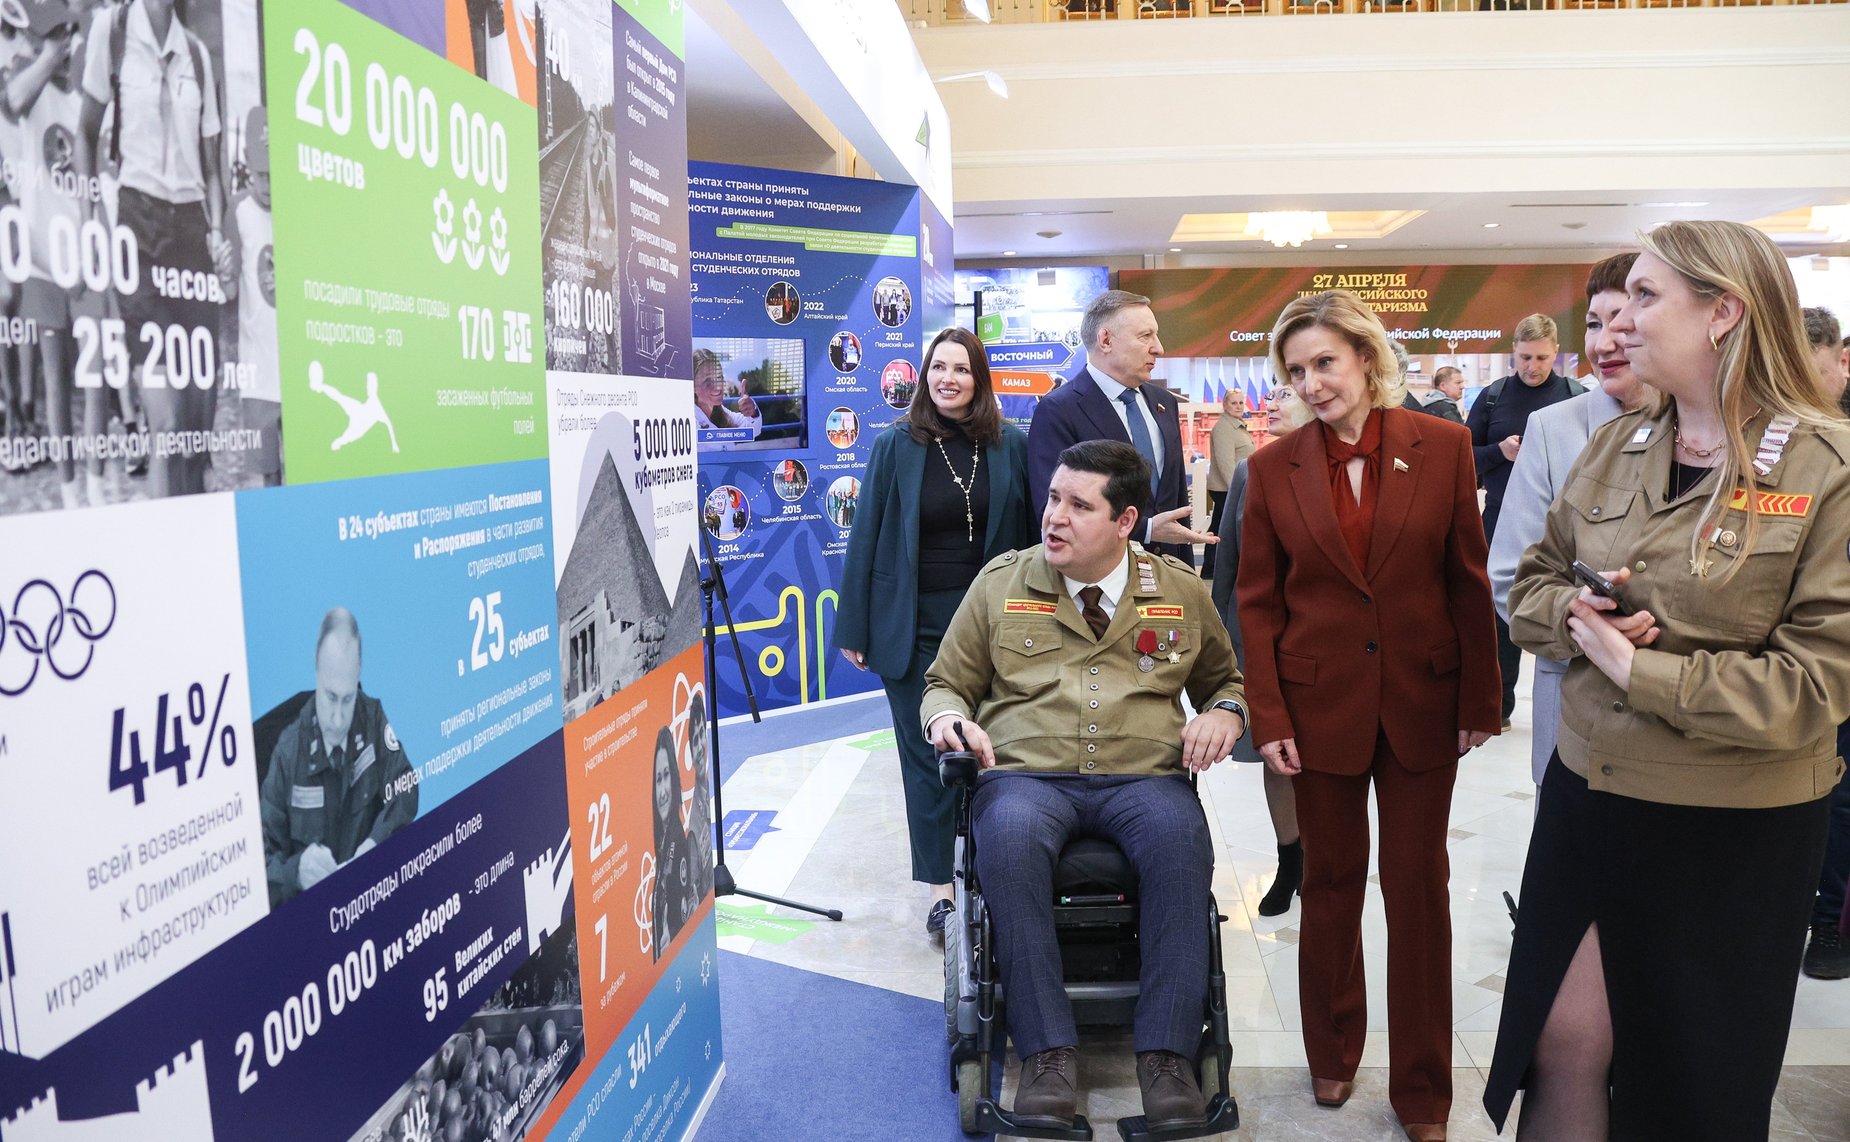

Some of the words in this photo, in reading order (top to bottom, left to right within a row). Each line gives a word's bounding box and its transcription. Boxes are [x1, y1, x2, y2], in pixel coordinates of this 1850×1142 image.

[294, 28, 352, 136] 20
[366, 62, 439, 168] 000
[450, 102, 507, 193] 000
[51, 161, 113, 205] боле
[298, 143, 365, 190] цветов
[725, 180, 763, 192] страны
[765, 184, 809, 197] приняты
[721, 207, 775, 219] движения
[725, 193, 763, 205] законы
[774, 198, 804, 209] мерах
[807, 201, 861, 215] поддержки
[48, 213, 140, 295] 000
[692, 264, 759, 276] СТУДЕНЧЕСКИХ
[761, 267, 800, 278] ОТРЯДОВ
[744, 253, 795, 265] ОТДЕЛЕНИЯ
[304, 279, 362, 307] посадили
[365, 288, 414, 314] трудовые
[1312, 274, 1334, 288] 27
[1336, 273, 1407, 288] АПРЕЛЯ
[1354, 288, 1428, 300] СИЙСКОГО
[552, 279, 581, 330] 160
[585, 286, 613, 335] 000
[804, 302, 824, 311] 2022
[72, 316, 129, 389] 25
[139, 321, 215, 390] 200
[222, 361, 257, 390] лет
[306, 320, 375, 346] подростков
[386, 328, 403, 347] это
[458, 305, 495, 361] 170
[885, 332, 903, 341] 2021
[991, 348, 1054, 362] ВОСТОЧНЫЙ
[1229, 330, 1265, 342] Совет
[1432, 328, 1502, 343] Федерации
[836, 376, 857, 386] 2020
[1002, 377, 1031, 387] КАМАЗ
[155, 430, 262, 458] деятельности
[633, 419, 642, 462] 5
[645, 418, 668, 460] 000
[671, 417, 692, 457] 000
[836, 453, 855, 462] 2018
[635, 465, 676, 494] кубометров
[676, 464, 693, 481] снега
[338, 517, 347, 541] В
[350, 515, 363, 539] 24
[365, 510, 418, 540] субъектах
[420, 505, 453, 528] страны
[454, 499, 487, 519] имеются
[488, 490, 542, 513] Постановления
[782, 505, 802, 514] 2015
[414, 543, 421, 560] и
[422, 529, 485, 558] Распоряжения
[493, 524, 513, 541] части
[514, 516, 543, 536] развития
[718, 544, 739, 554] 2014
[468, 550, 517, 580] студенческих
[458, 659, 464, 677] в
[469, 591, 504, 672] 25
[509, 624, 549, 657] субъектах
[441, 706, 475, 739] приняты
[476, 680, 527, 722] региональные
[529, 668, 552, 690] законы
[109, 673, 237, 806] 44%
[394, 765, 424, 796] мерах
[425, 738, 472, 776] поддержки
[473, 712, 521, 753] деятельности
[522, 693, 553, 723] движения
[87, 843, 133, 891] всей
[138, 792, 244, 867] возведенной
[588, 792, 612, 863] 22
[119, 898, 132, 923] к
[135, 837, 247, 913] Олимпийским
[329, 871, 399, 934] Студотряды
[400, 833, 454, 886] покрасили
[455, 812, 483, 844] более
[474, 872, 488, 897] это
[490, 850, 515, 885] длина
[45, 960, 109, 1015] играм
[113, 877, 251, 974] инфраструктуры
[455, 926, 494, 974] Великих
[457, 947, 503, 999] китайских
[503, 926, 522, 955] стен
[594, 912, 608, 984] 7
[234, 1031, 259, 1095] 2
[263, 981, 322, 1068] 000
[327, 938, 377, 1016] 000
[382, 937, 403, 973] км
[405, 892, 461, 953] заборов
[423, 966, 449, 1023] 95
[627, 1022, 651, 1090] 341
